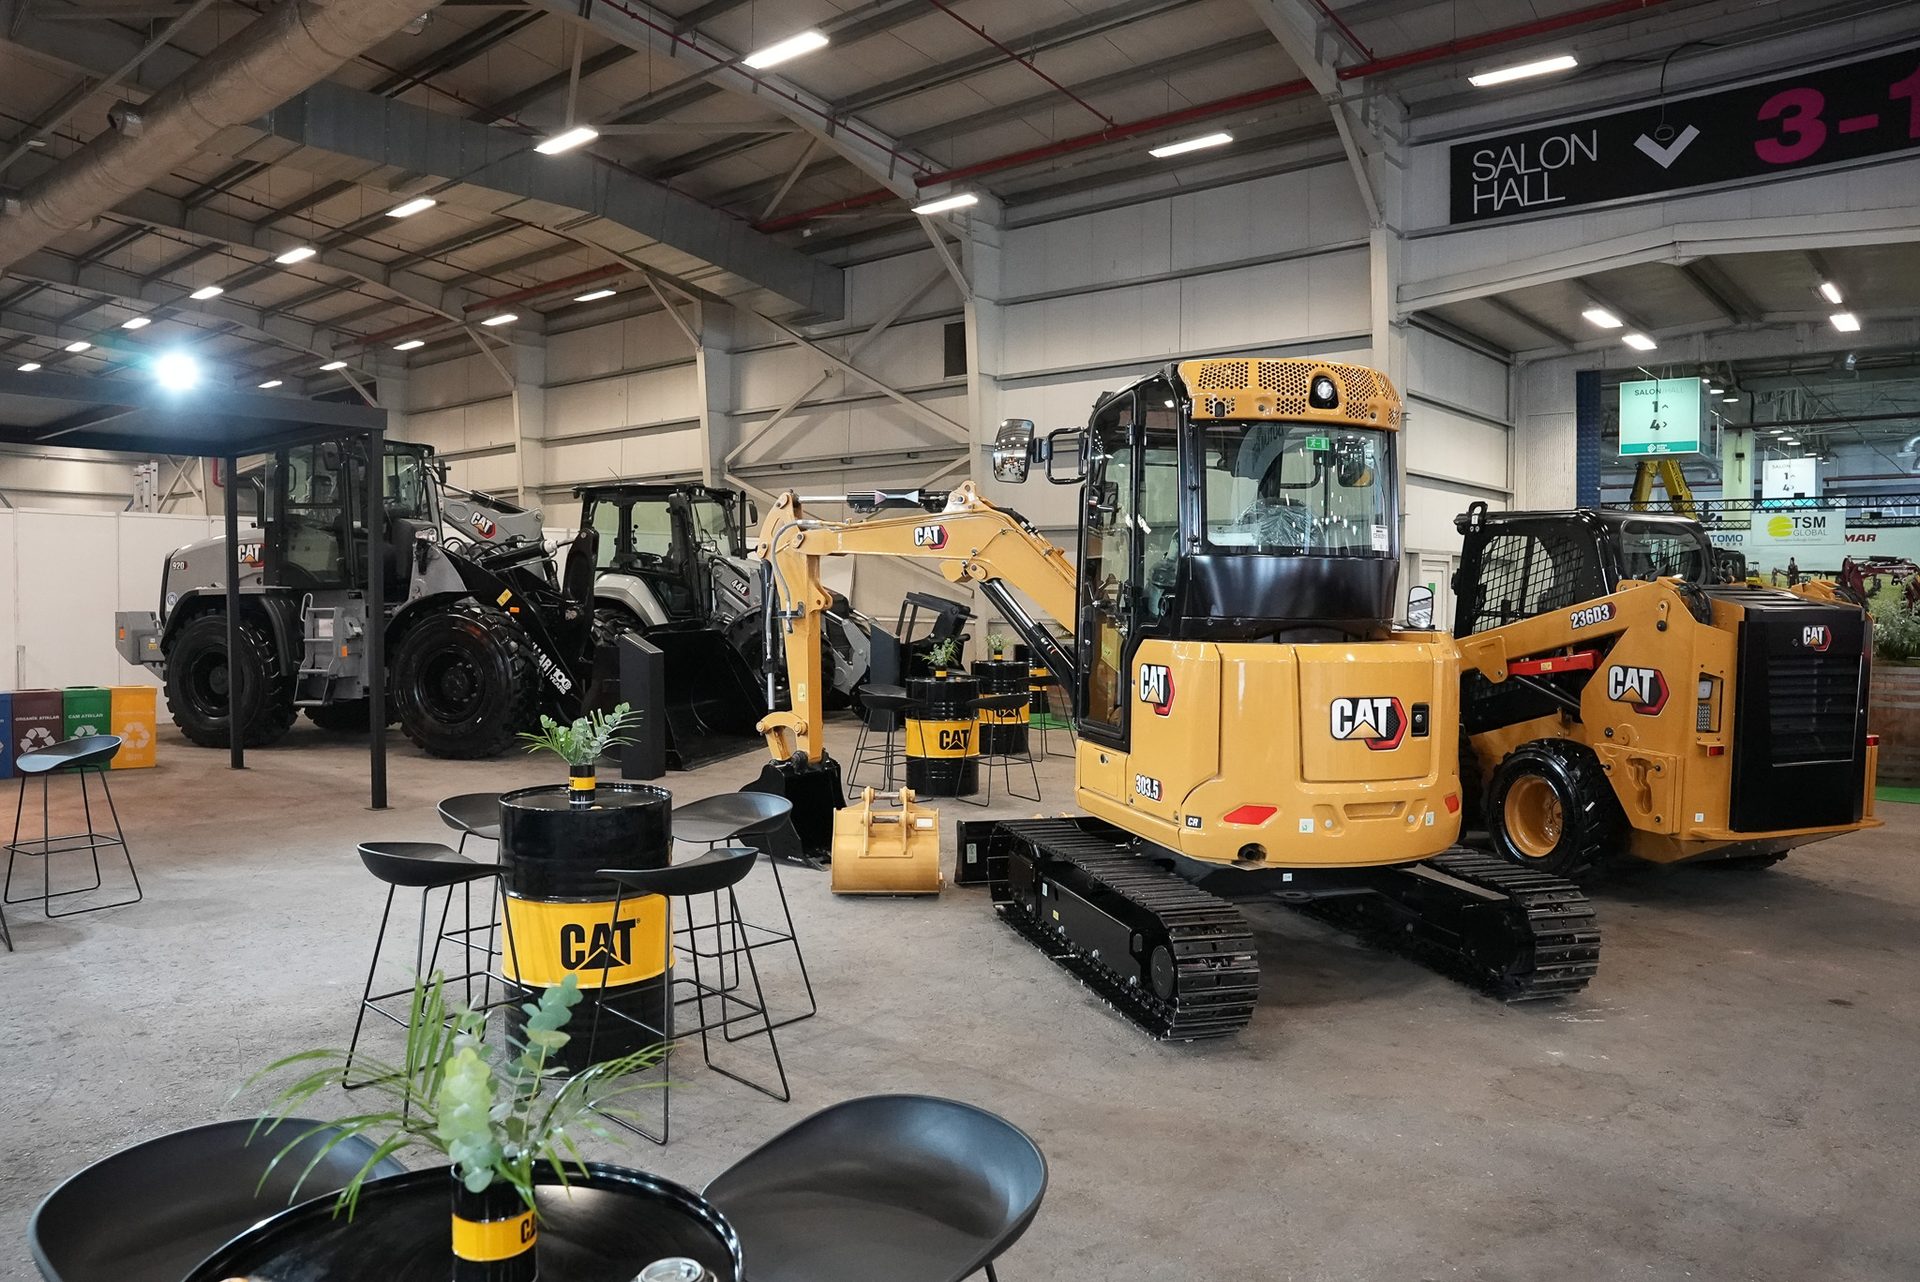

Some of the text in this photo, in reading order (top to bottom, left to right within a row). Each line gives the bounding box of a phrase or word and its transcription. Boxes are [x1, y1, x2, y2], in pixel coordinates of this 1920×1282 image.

[1471, 128, 1598, 183] SALON
[1473, 171, 1566, 214] HALL
[1652, 401, 1659, 413] 1
[1650, 419, 1660, 430] 4
[470, 512, 493, 533] CAT
[1792, 516, 1826, 528] TSM
[914, 526, 940, 546] CAT
[1793, 529, 1828, 537] GLOBAL
[238, 544, 261, 563] CAT
[172, 561, 185, 570] 920
[731, 579, 748, 594] 444
[1570, 603, 1610, 629] 236D3
[1803, 626, 1825, 645] CAT
[1140, 664, 1167, 704] CAT
[1608, 665, 1655, 704] CAT
[1331, 698, 1392, 739] CAT
[939, 729, 969, 750] CAT
[1135, 774, 1159, 799] 303.5
[1187, 817, 1199, 827] CR
[560, 917, 637, 971] CAT
